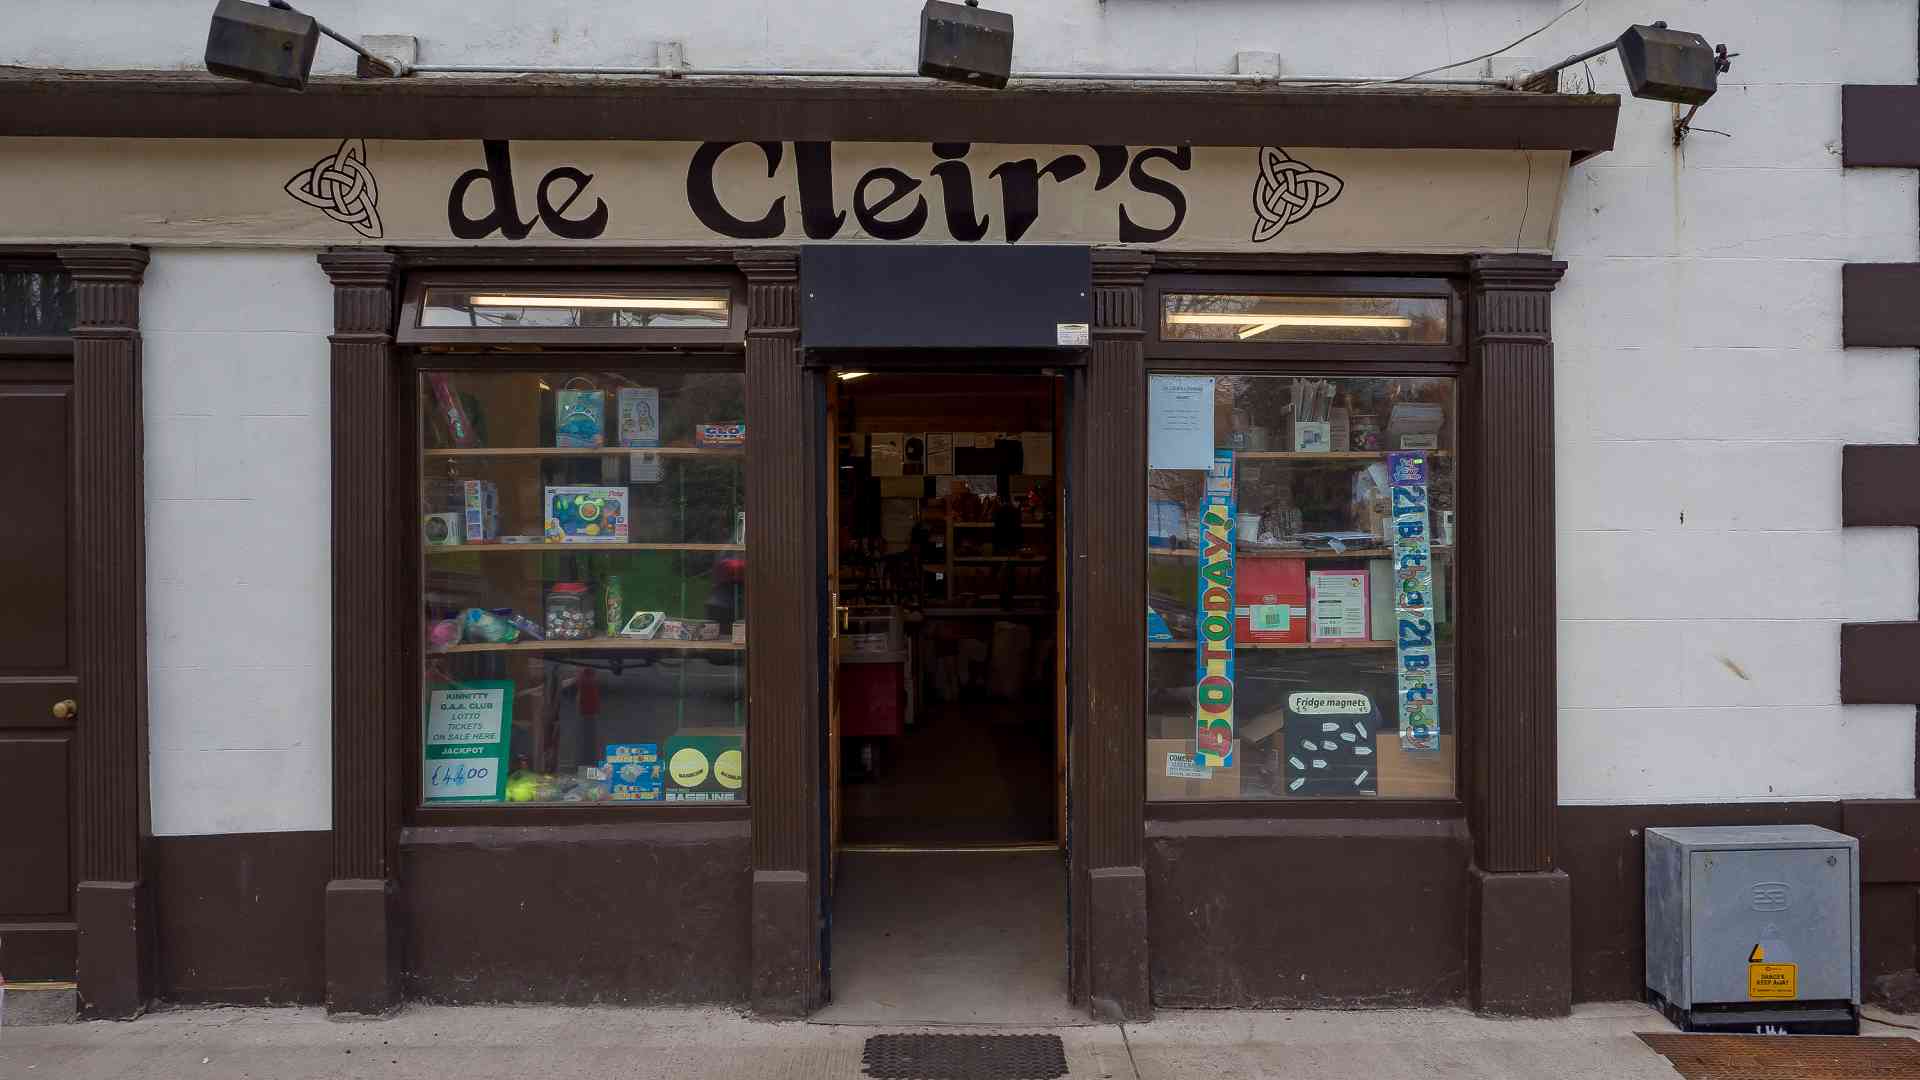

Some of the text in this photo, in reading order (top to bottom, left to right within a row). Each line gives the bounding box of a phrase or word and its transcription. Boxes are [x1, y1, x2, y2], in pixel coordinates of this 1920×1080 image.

[448, 139, 608, 241] de
[1296, 697, 1365, 708] Fridge magnets
[473, 732, 497, 740] HERE
